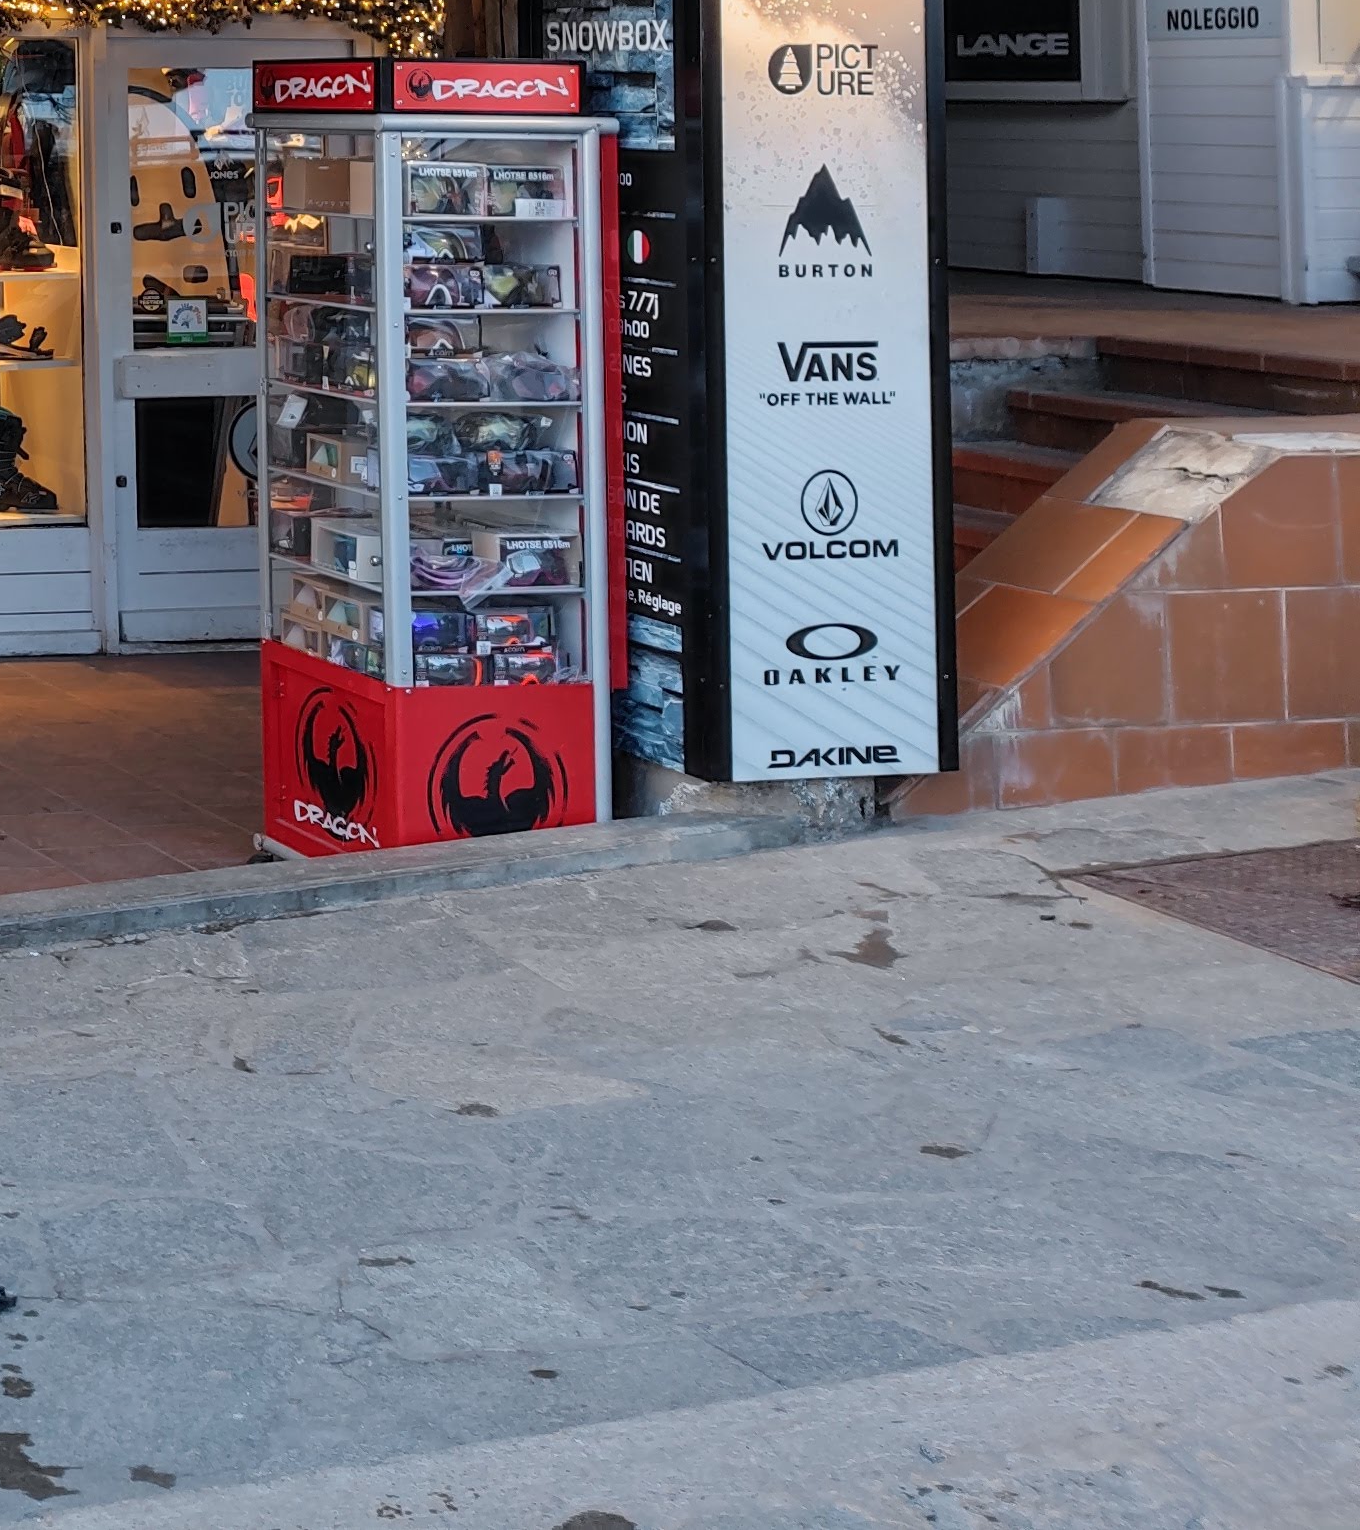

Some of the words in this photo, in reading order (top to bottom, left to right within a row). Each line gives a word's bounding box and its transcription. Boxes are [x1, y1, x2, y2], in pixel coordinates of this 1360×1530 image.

[1166, 6, 1260, 32] NOLEGGIO
[546, 19, 670, 52] SNOWBOX
[956, 32, 1070, 58] LANGE
[815, 43, 879, 70] PICT
[273, 69, 372, 104] DRAGON
[431, 76, 570, 101] DRAGON
[815, 69, 875, 96] URE
[778, 264, 873, 278] BURTON
[627, 290, 660, 320] 7/7j
[777, 341, 879, 382] VANS
[758, 392, 801, 408] "OFF
[806, 391, 839, 407] THE
[843, 390, 896, 406] WALL"
[640, 491, 661, 515] DE
[506, 539, 542, 550] LHOTSE
[761, 538, 900, 561] VOLCOM
[638, 588, 682, 617] Réglage
[763, 664, 901, 686] OAKLEY
[766, 744, 902, 770] DAKINE
[293, 798, 381, 849] DRAGON
